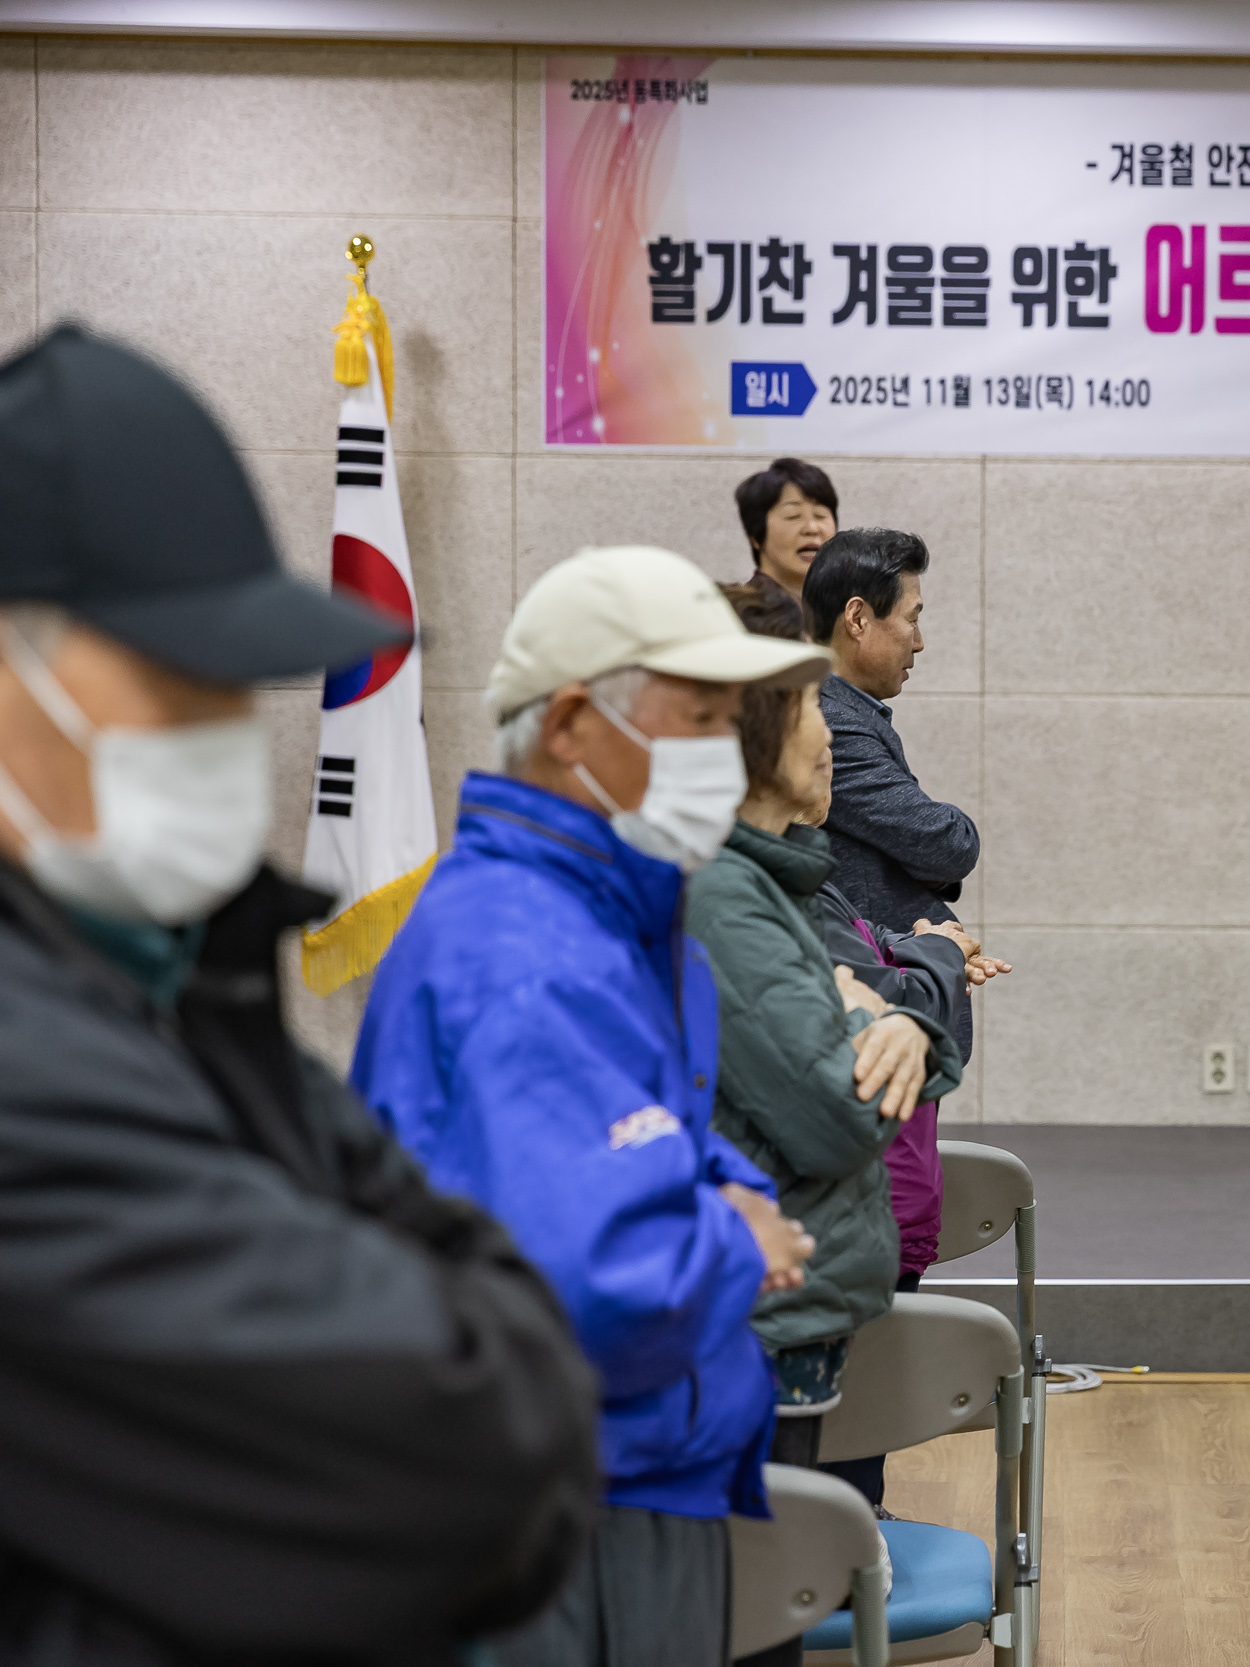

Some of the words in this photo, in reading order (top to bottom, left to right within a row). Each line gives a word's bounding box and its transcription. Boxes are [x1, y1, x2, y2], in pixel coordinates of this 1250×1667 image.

[570, 78, 628, 104] 2025년
[1111, 141, 1193, 186] 겨울철
[646, 235, 812, 325] 활기찬
[832, 244, 990, 327] 겨울을
[1011, 242, 1117, 329] 위한
[746, 372, 788, 406] 일시
[830, 376, 909, 406] 2025년
[924, 376, 970, 407] 11월
[984, 376, 1073, 409] 13일(목)
[1087, 379, 1150, 407] 14:00
